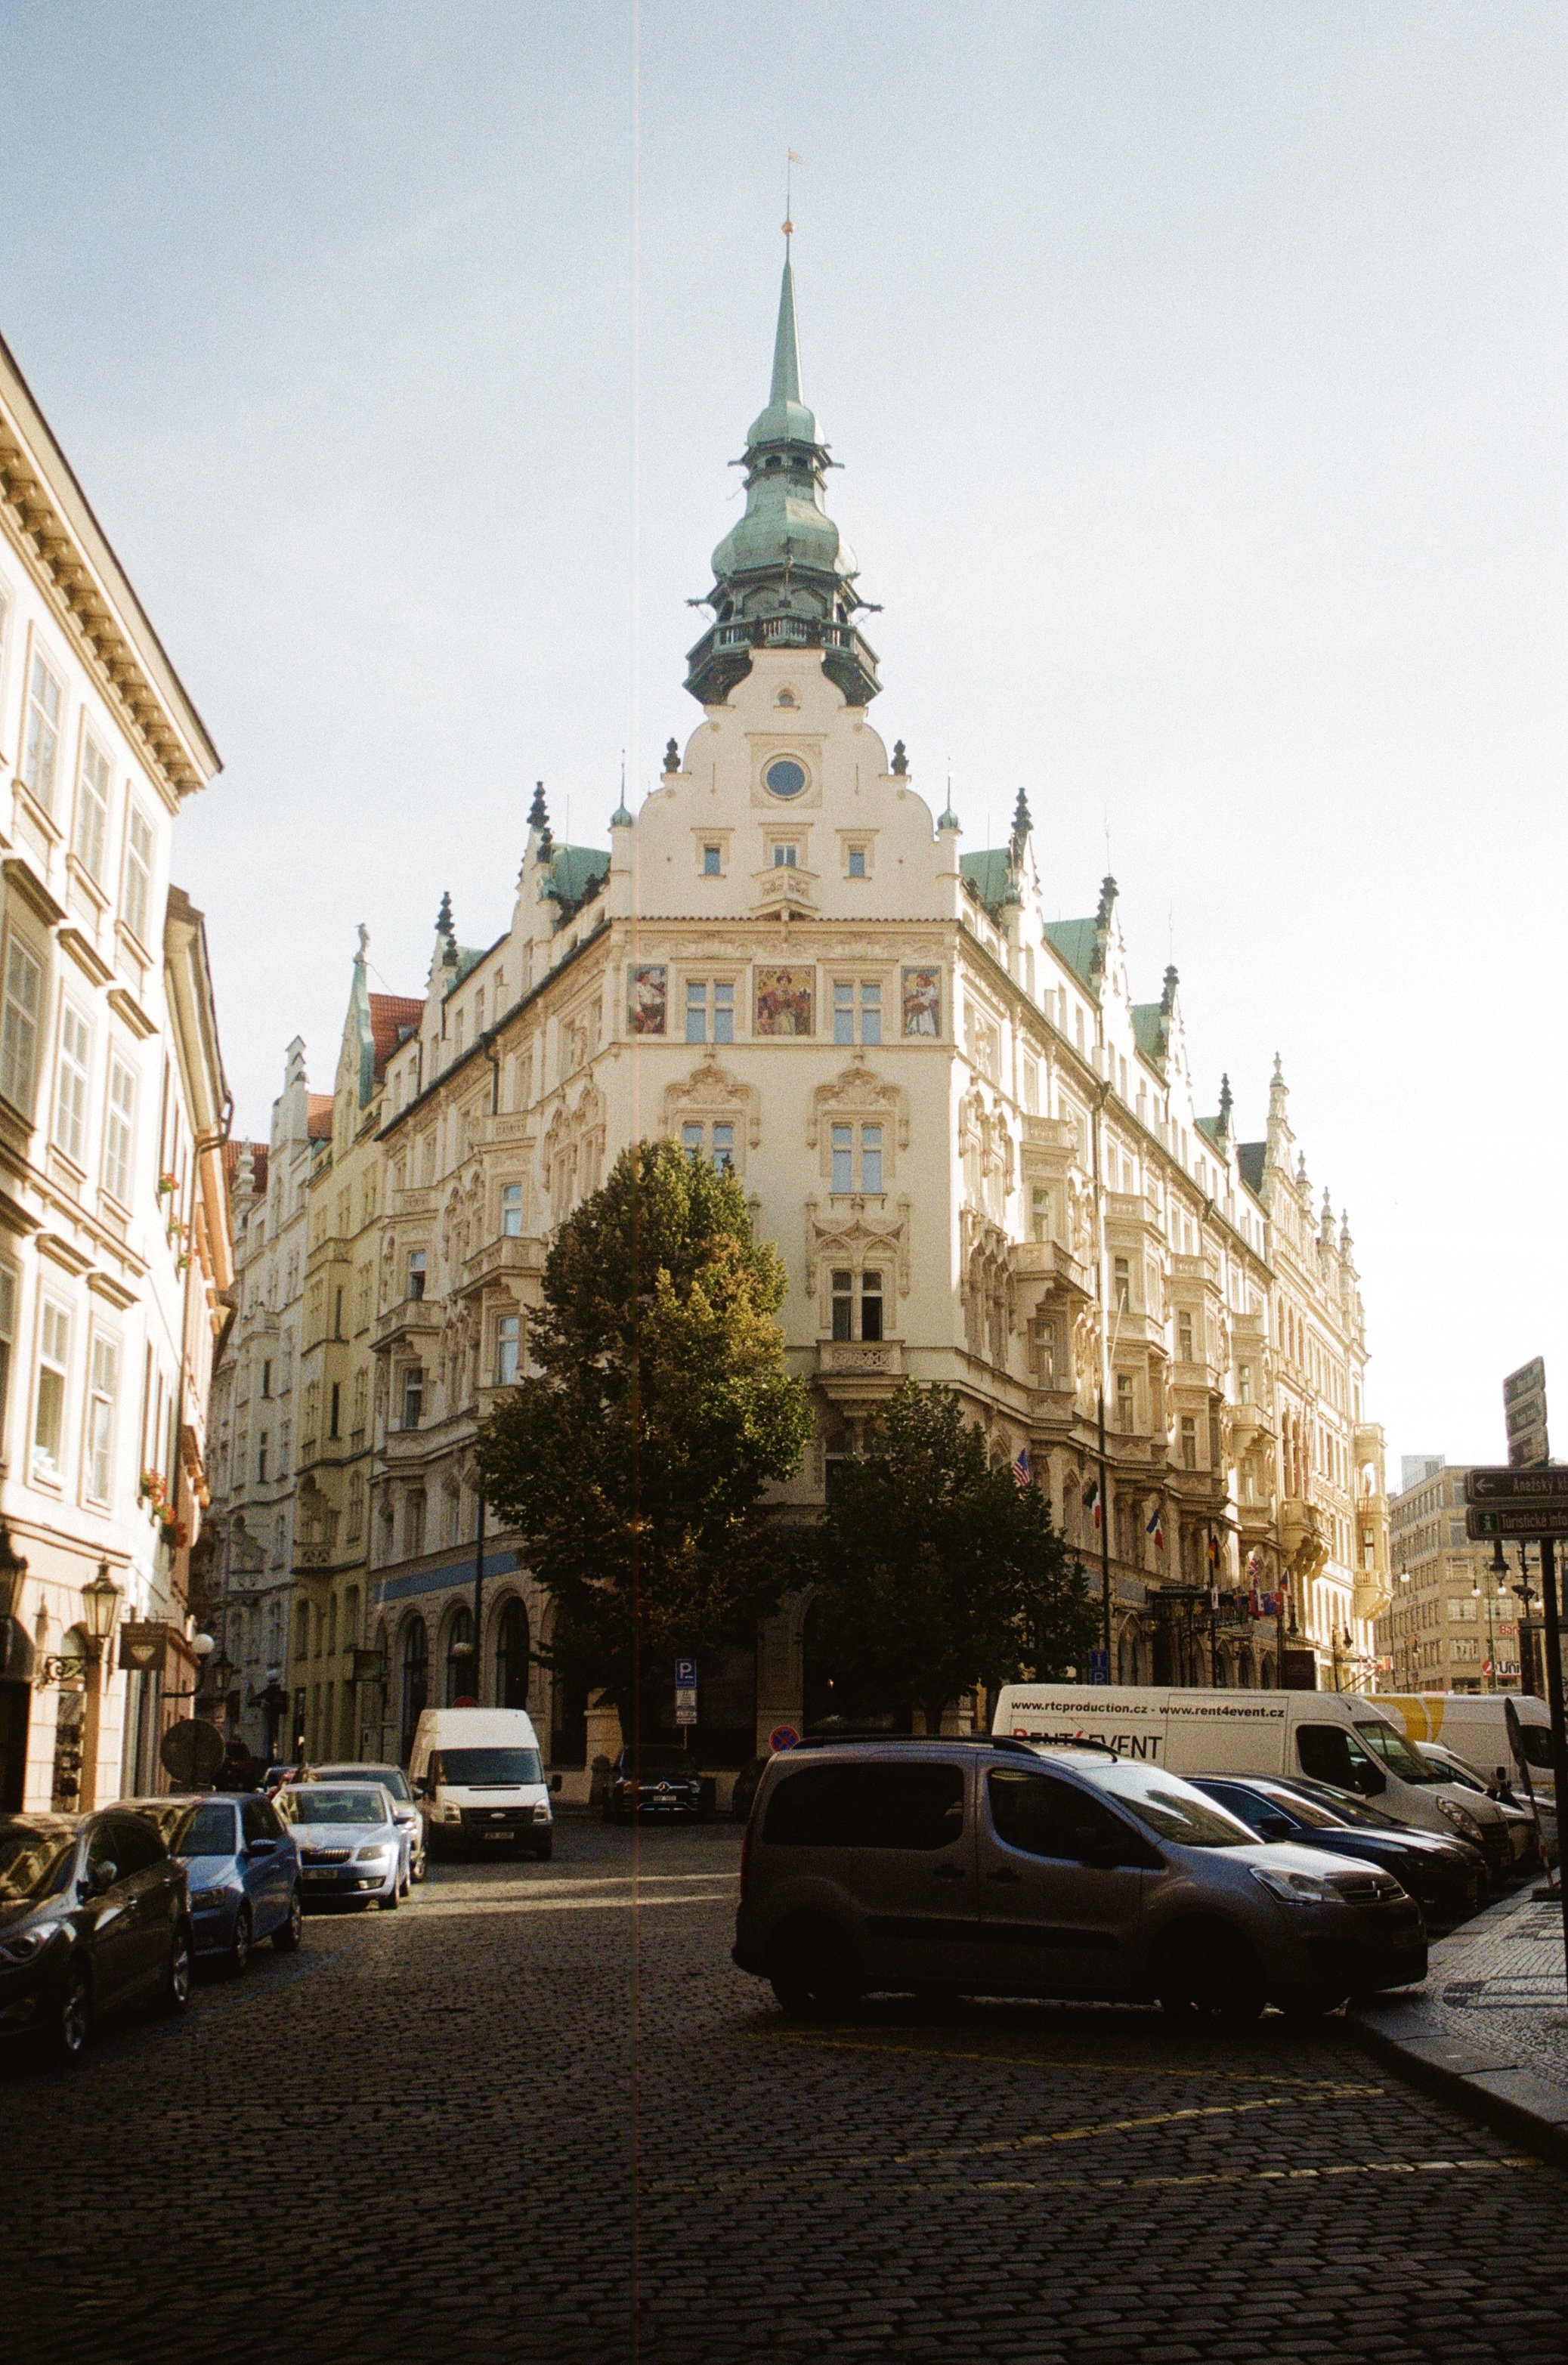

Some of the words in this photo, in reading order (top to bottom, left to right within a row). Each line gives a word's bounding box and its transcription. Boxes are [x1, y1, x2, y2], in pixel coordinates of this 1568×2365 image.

[1501, 1512, 1547, 1529] Turistické
[680, 1662, 691, 1679] P
[1095, 1672, 1104, 1686] P
[1011, 1702, 1147, 1713] www.rtcproduction.cz
[1159, 1706, 1285, 1717] www.rent4event.cz
